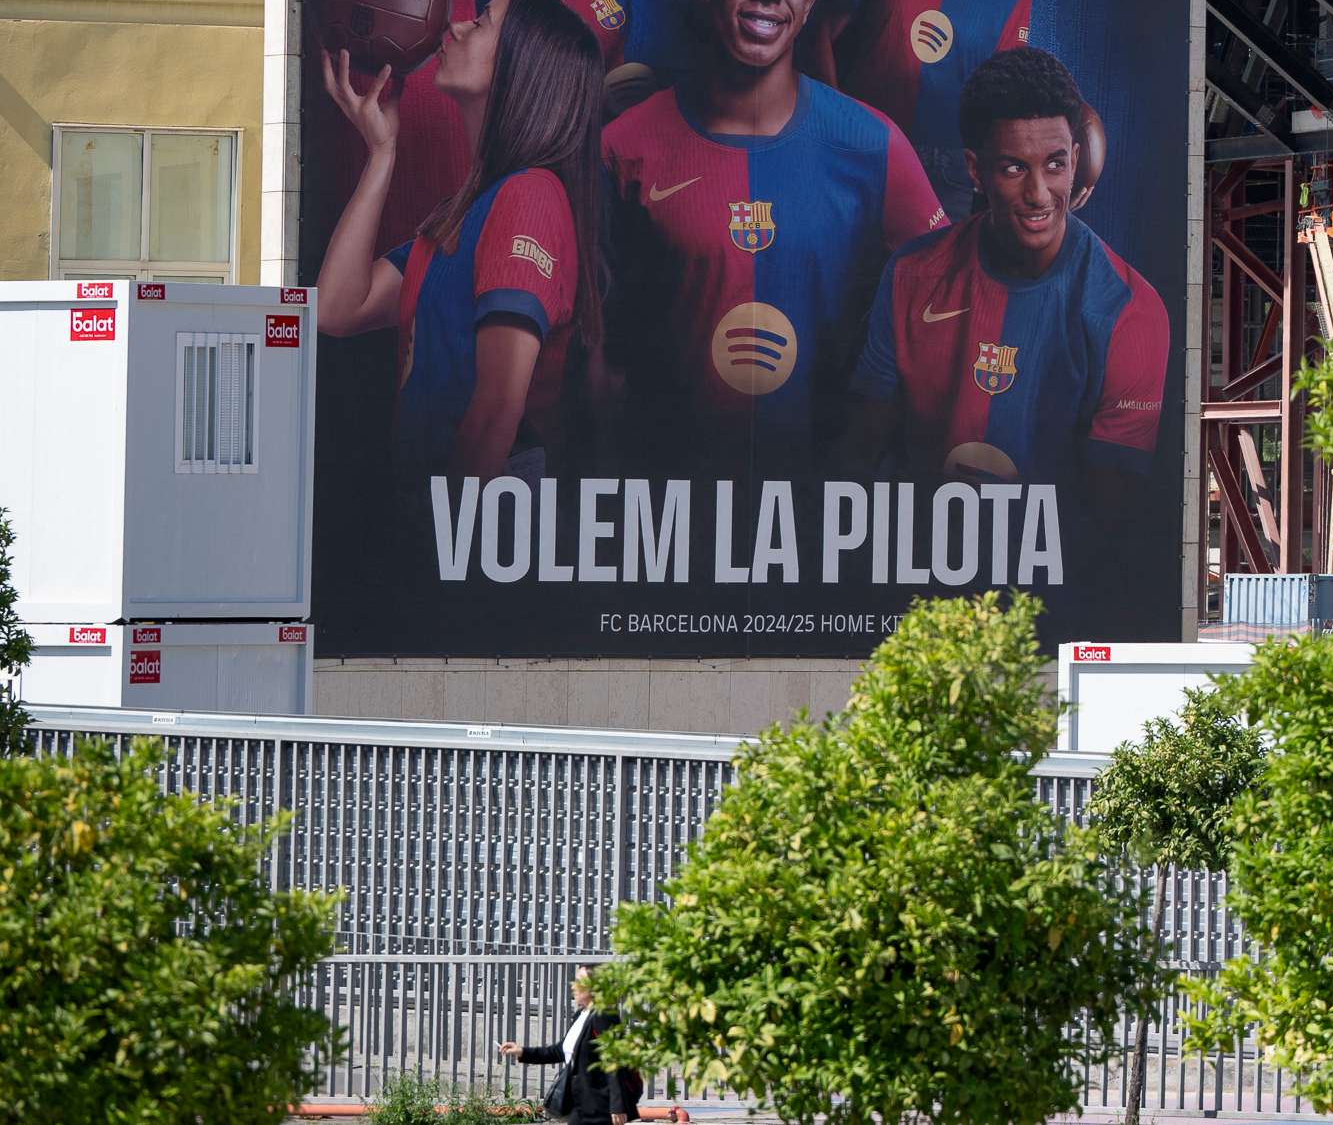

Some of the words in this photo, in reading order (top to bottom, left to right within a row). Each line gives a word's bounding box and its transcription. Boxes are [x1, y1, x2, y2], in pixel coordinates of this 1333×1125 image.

[72, 311, 114, 332] balat
[267, 318, 298, 338] balat
[430, 475, 691, 583] VOLEM
[715, 480, 799, 584] LA
[822, 481, 1064, 587] PILOTA
[600, 614, 622, 633] FC
[627, 614, 739, 634] BARCELONA
[743, 613, 815, 635] 2024/25
[820, 614, 874, 634] HOME
[881, 615, 905, 635] KI
[1078, 646, 1107, 660] balat
